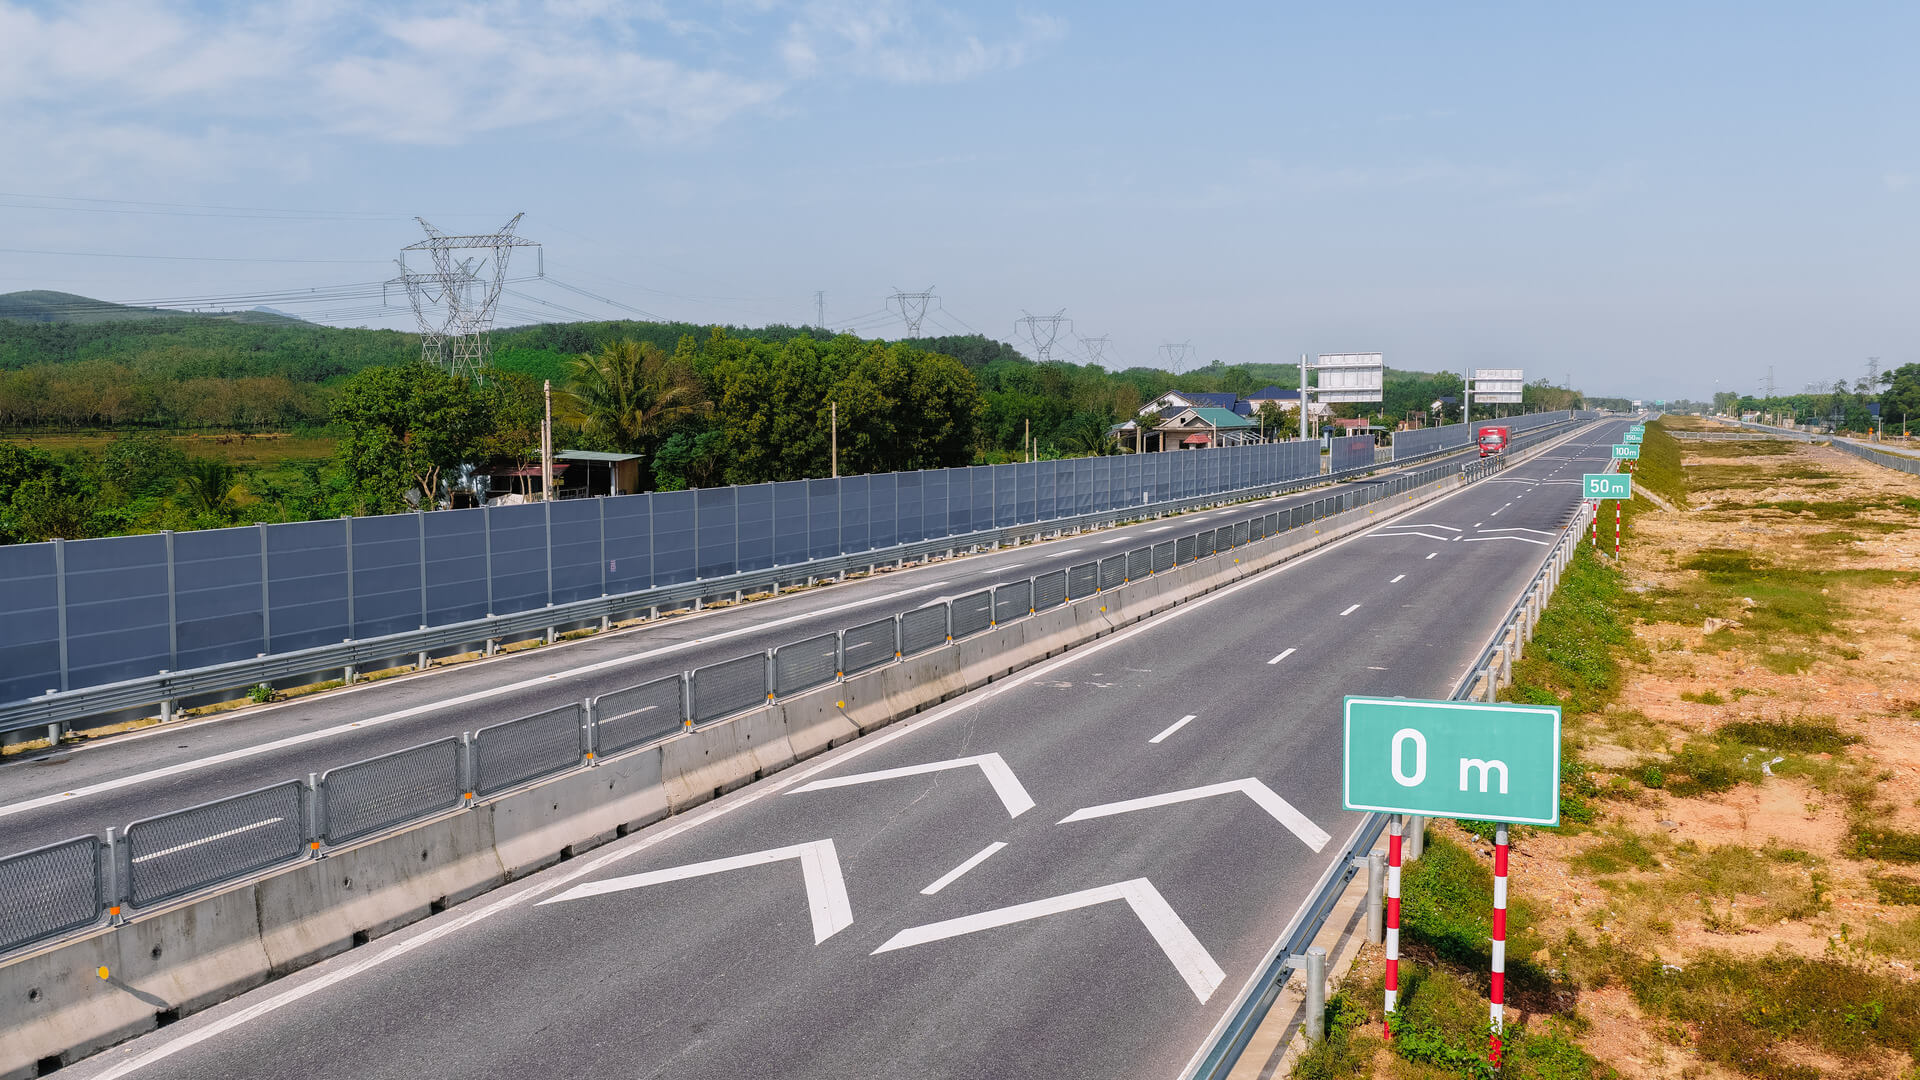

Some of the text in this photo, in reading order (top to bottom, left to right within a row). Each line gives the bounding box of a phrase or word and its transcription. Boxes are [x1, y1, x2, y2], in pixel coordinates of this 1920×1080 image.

[1590, 479, 1624, 494] 50 m
[1391, 728, 1509, 794] 0 m
